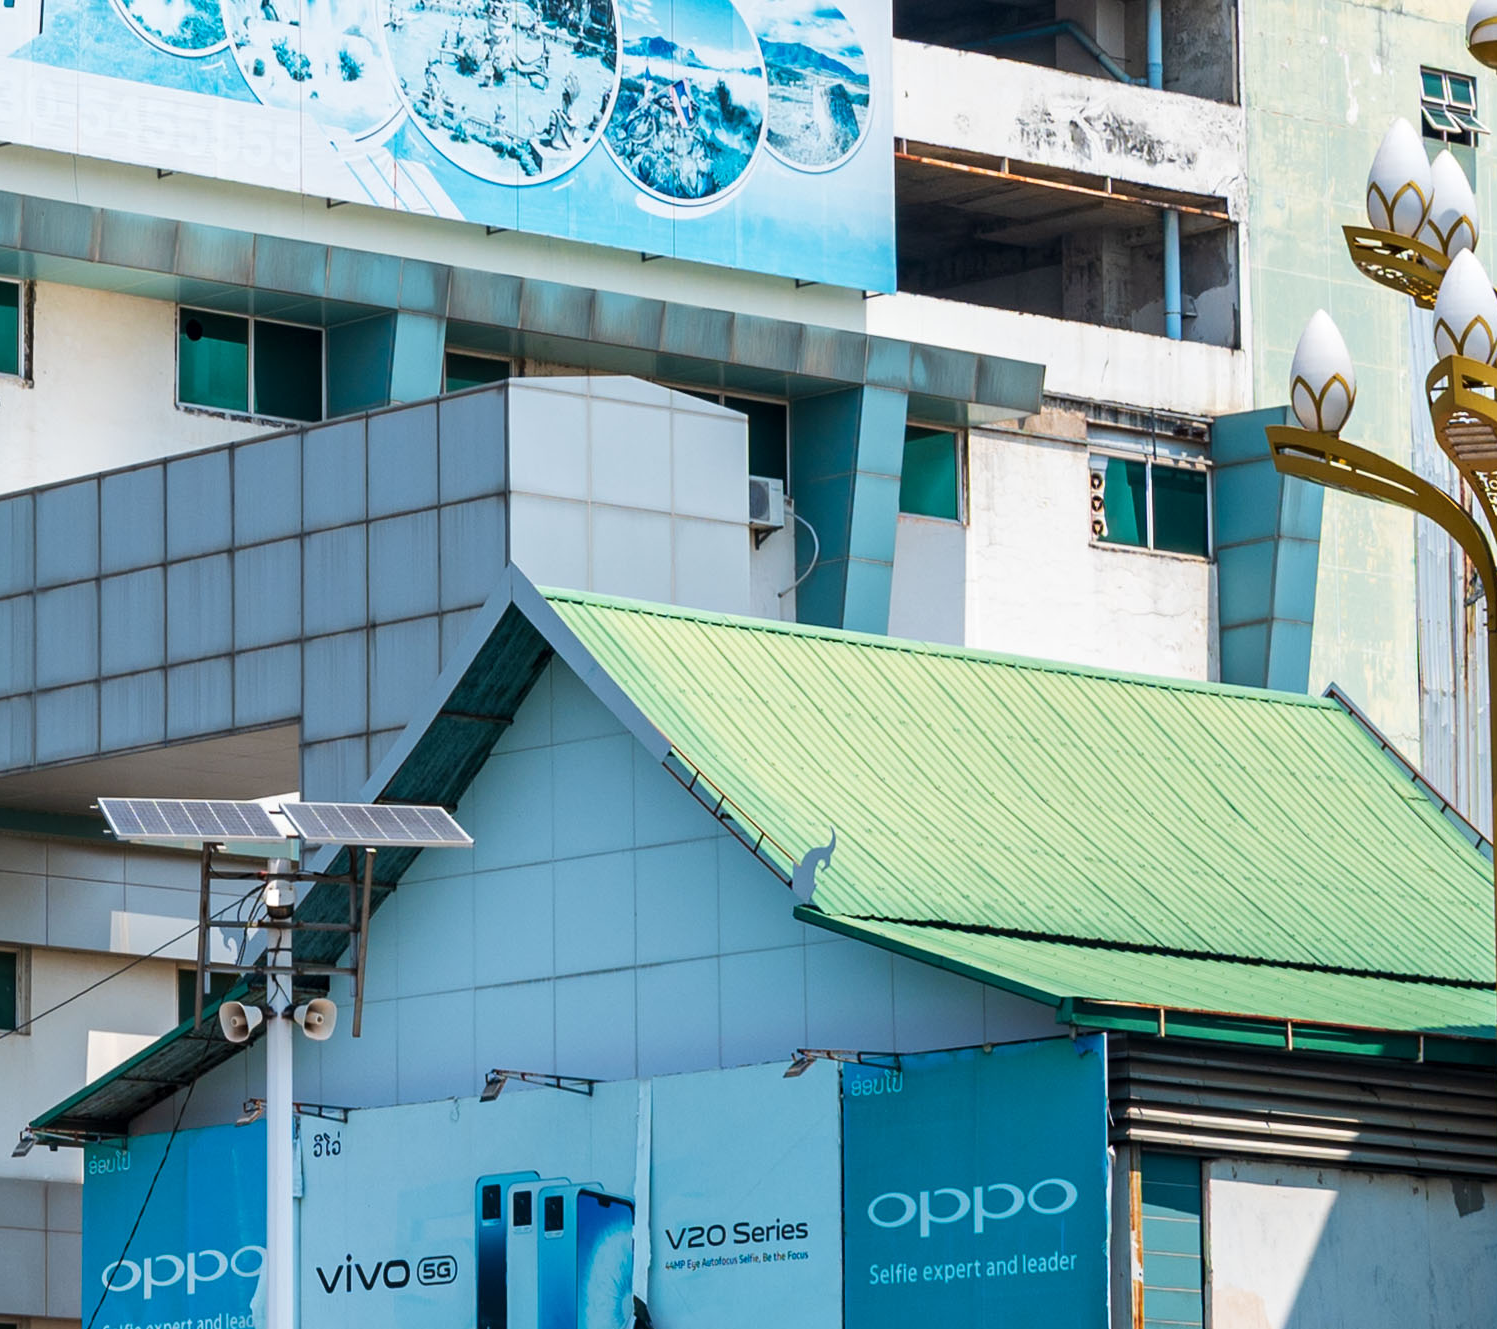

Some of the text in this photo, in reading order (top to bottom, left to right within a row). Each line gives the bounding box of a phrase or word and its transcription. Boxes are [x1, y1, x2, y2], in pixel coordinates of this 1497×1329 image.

[665, 1218, 809, 1251] V20 Series
[316, 1253, 452, 1294] vivo 5G
[687, 1258, 701, 1272] Eye
[702, 1255, 738, 1268] Autofocus
[762, 1252, 772, 1263] Be
[773, 1251, 786, 1262] the
[787, 1249, 809, 1261] Focus
[869, 1251, 1078, 1285] Selfie expert and leader
